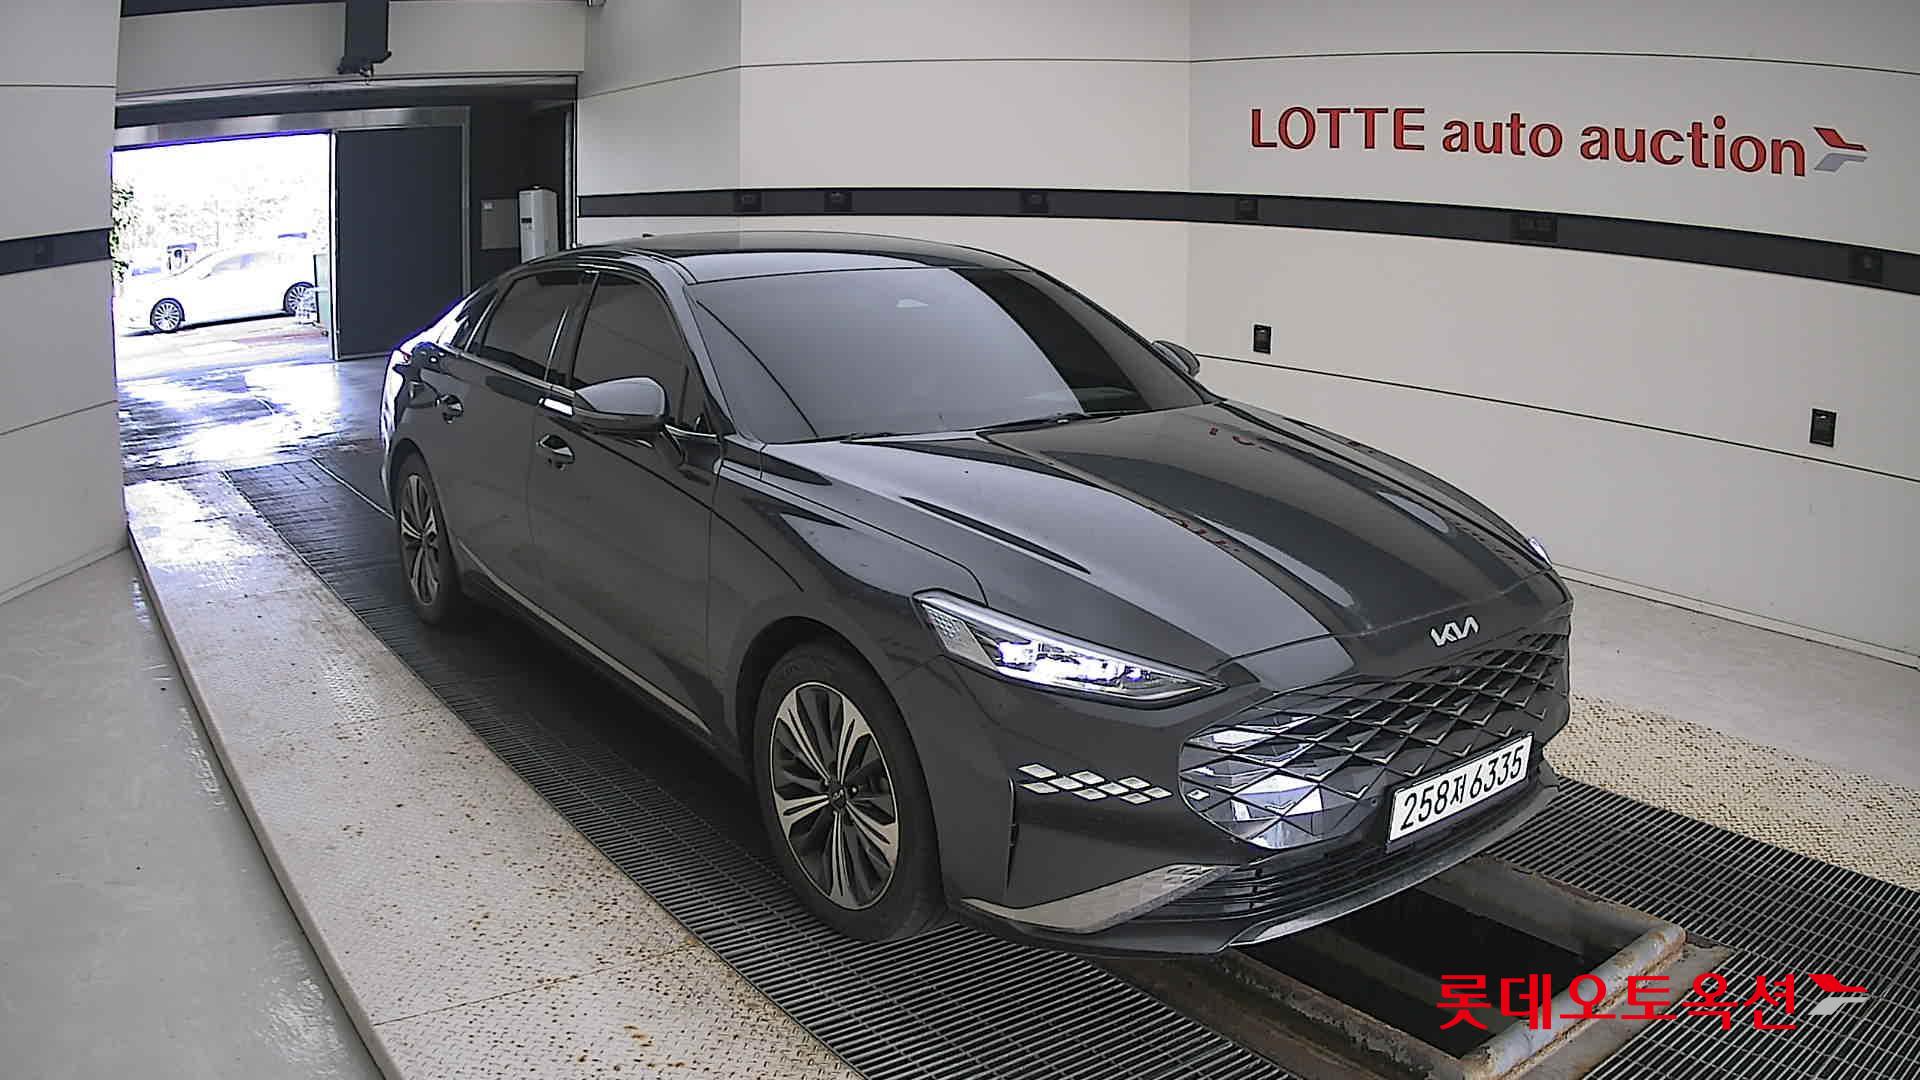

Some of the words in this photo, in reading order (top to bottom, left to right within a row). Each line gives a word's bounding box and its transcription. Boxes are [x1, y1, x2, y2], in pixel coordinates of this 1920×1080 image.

[1251, 107, 1425, 151] LOTTE
[1442, 113, 1563, 158] auto
[1581, 116, 1807, 176] auction
[1430, 616, 1479, 646] KIA
